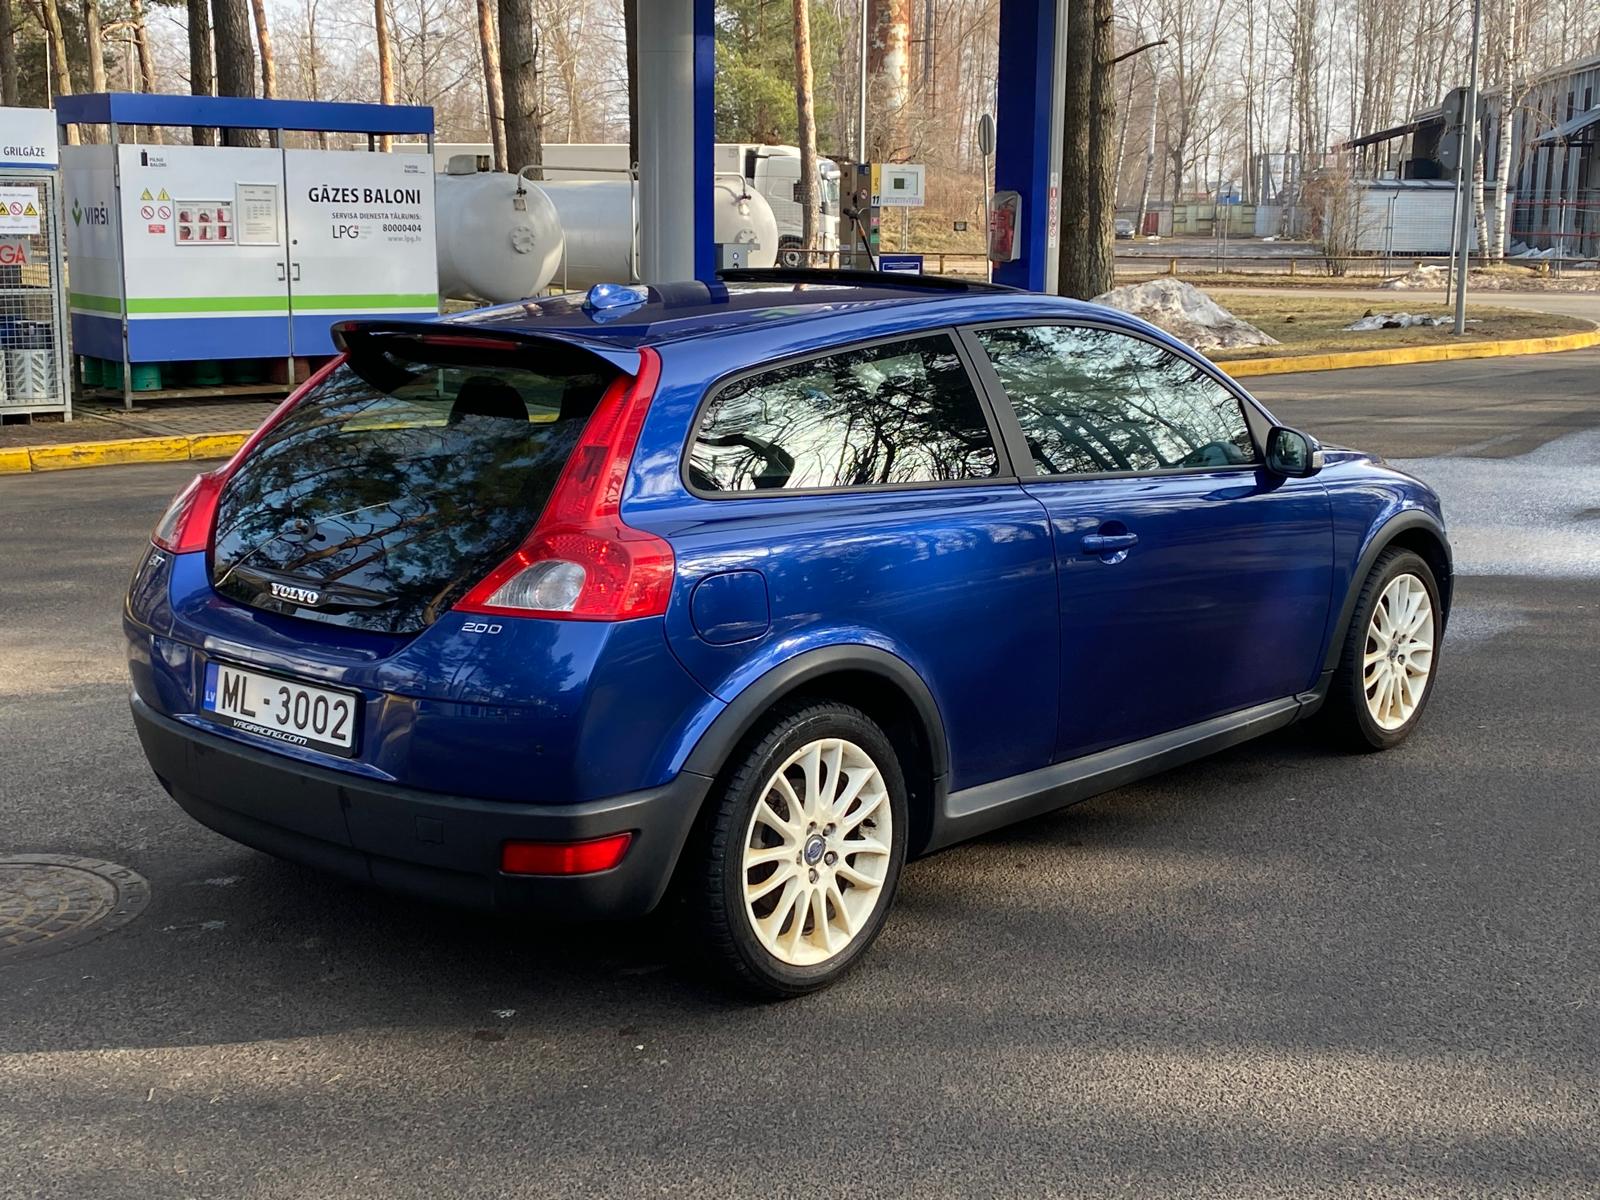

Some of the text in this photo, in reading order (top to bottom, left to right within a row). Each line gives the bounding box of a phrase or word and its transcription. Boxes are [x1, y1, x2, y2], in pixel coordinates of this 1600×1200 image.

[308, 184, 421, 204] GĀZES BALONI
[332, 225, 359, 239] LPG
[383, 224, 422, 232] 80000404
[271, 583, 319, 604] VOLVO
[206, 691, 216, 701] LV
